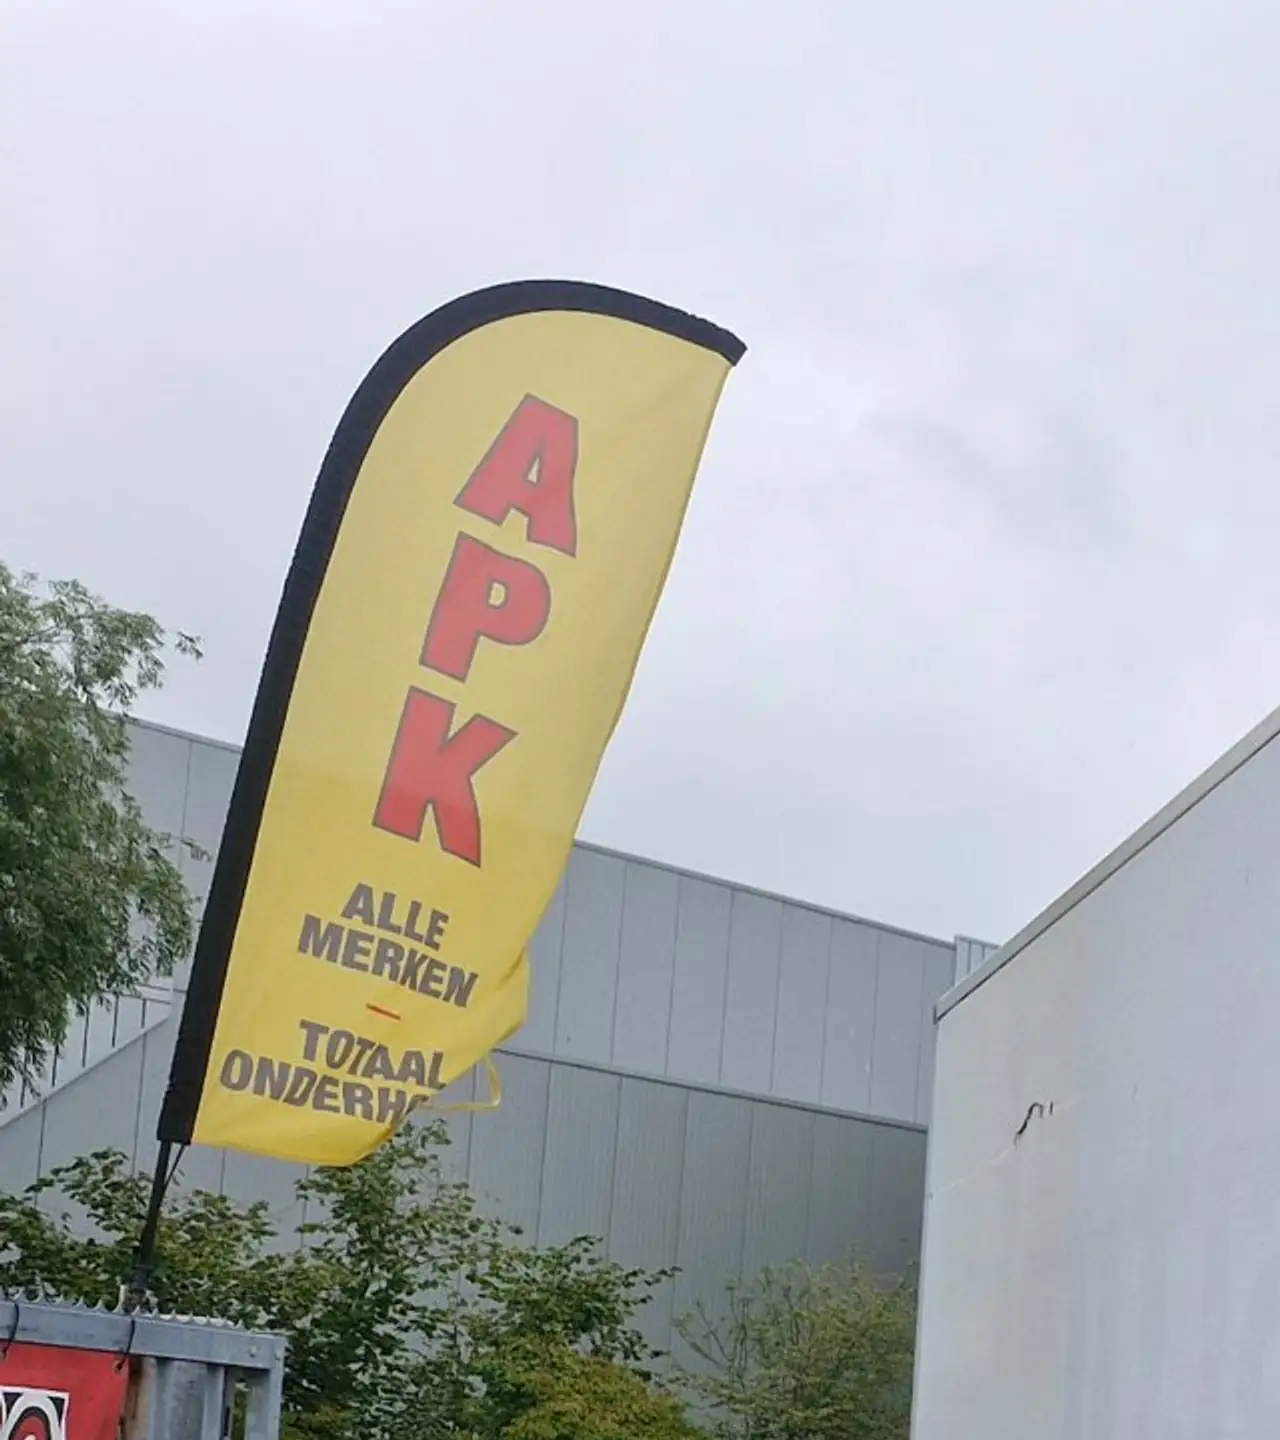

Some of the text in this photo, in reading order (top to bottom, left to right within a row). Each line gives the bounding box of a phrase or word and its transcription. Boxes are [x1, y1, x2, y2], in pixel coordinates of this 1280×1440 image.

[371, 393, 578, 868] APK
[341, 883, 449, 951] ALLE
[297, 913, 478, 1007] MERKEN
[299, 1018, 446, 1090] TOTAAL
